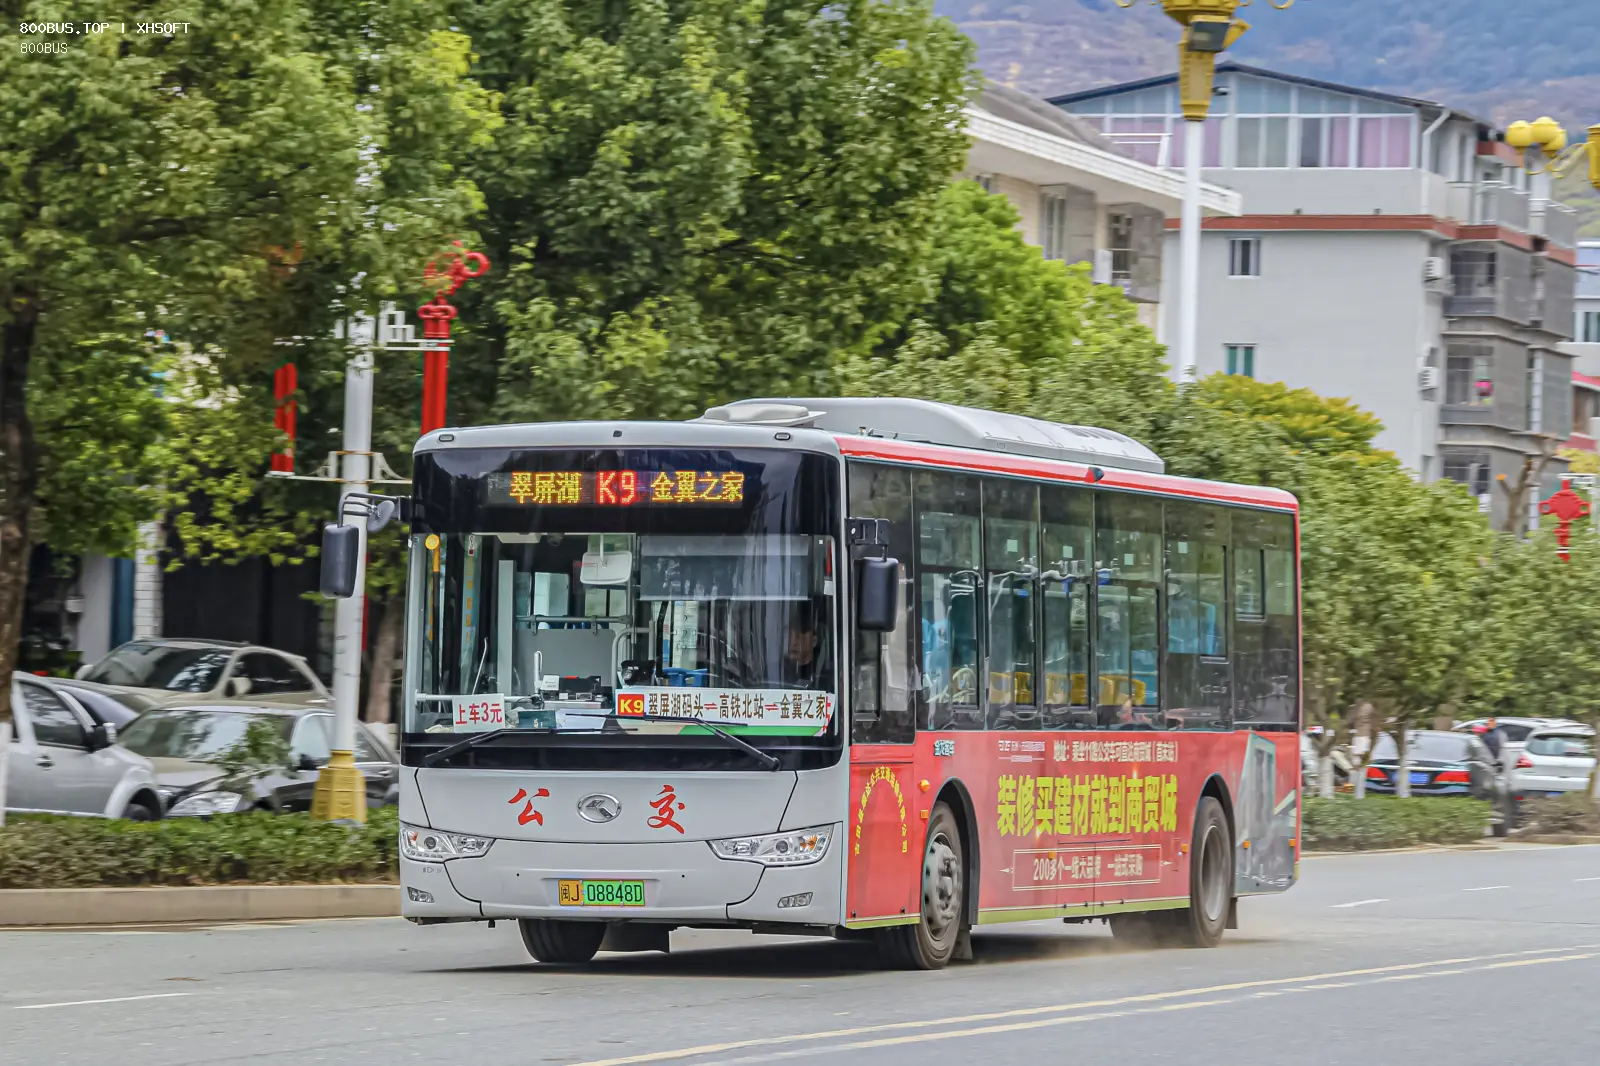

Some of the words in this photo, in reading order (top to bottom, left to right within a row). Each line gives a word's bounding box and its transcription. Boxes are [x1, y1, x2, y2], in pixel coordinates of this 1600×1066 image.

[509, 471, 583, 504] 翠屏湖
[597, 471, 637, 505] K9
[650, 471, 745, 502] 金翼之家
[455, 702, 503, 725] 上车3元
[620, 698, 644, 714] K9
[648, 692, 704, 719] 翠屏湖码头
[719, 692, 764, 719] 高铁北站
[780, 693, 827, 719] 金翼之家
[997, 774, 1177, 837] 装修买建材就到商贸城
